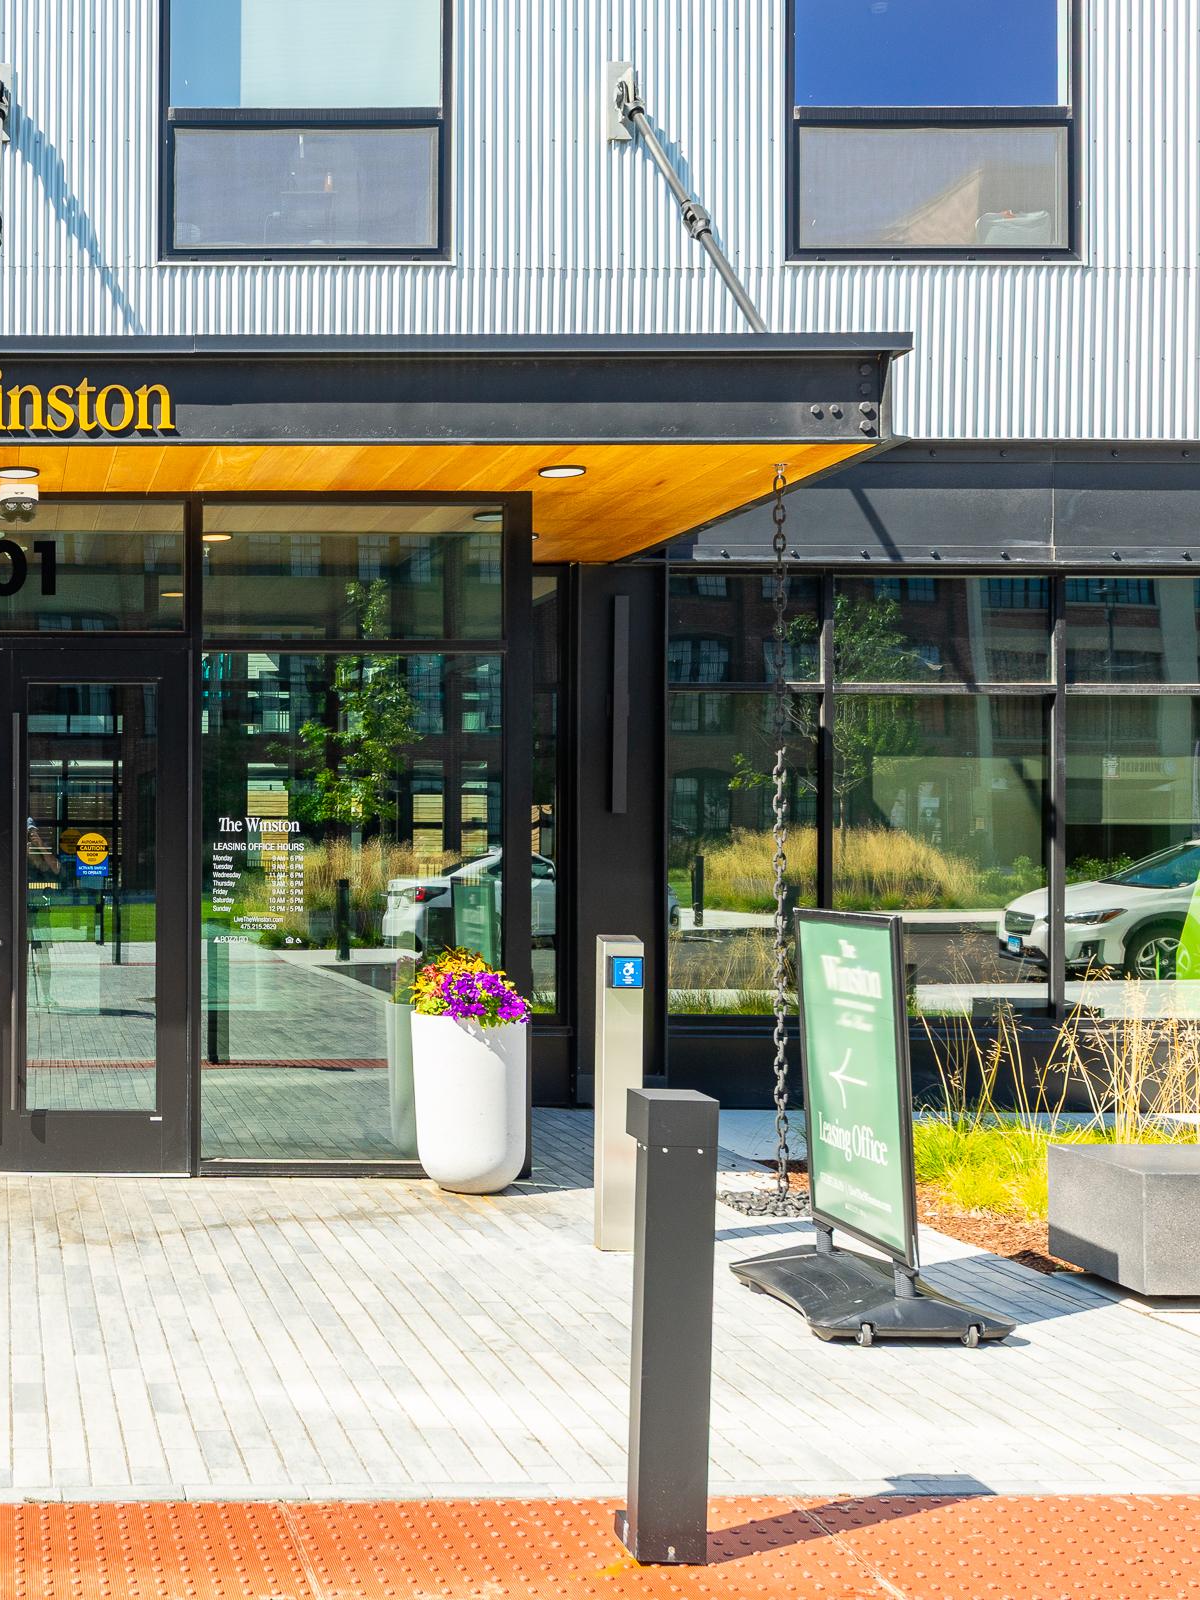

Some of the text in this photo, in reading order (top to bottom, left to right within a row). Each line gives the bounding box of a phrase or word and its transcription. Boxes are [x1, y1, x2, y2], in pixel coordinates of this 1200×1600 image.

[218, 817, 301, 833] The Winston
[213, 842, 305, 851] LEASING OFFICE HOURS
[212, 854, 233, 862] Monday
[212, 862, 234, 870] Tuesday
[819, 954, 883, 999] Winston
[818, 1111, 889, 1167] Leasing Office
